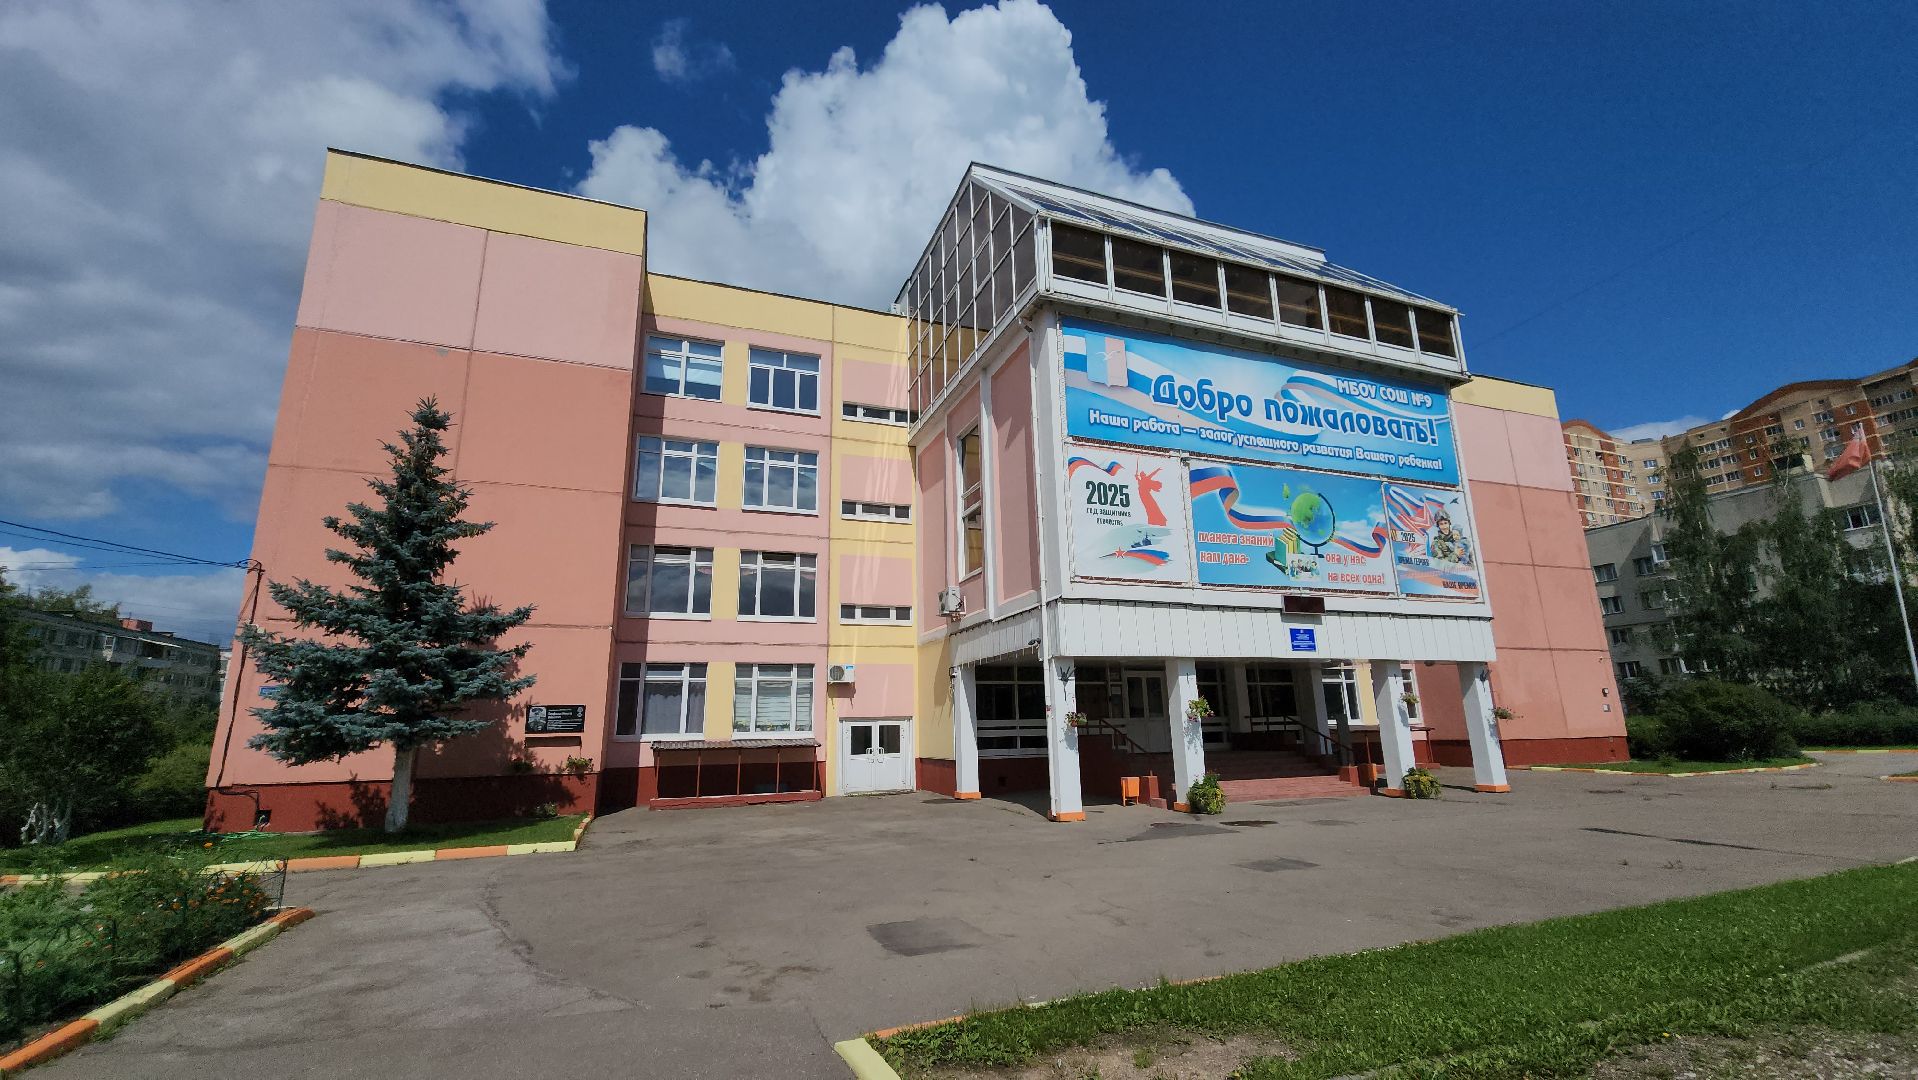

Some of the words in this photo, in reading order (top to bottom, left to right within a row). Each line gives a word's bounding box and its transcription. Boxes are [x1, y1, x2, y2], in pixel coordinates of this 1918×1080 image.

[1337, 379, 1376, 400] МБОУ
[1379, 386, 1409, 405] СОШ
[1411, 392, 1432, 409] №9
[1152, 374, 1253, 421] Добро
[1264, 398, 1438, 446] пожаловать!
[1089, 409, 1129, 428] Наша
[1133, 417, 1180, 434] работа
[1200, 428, 1233, 443] залог
[1236, 433, 1299, 451] успешного
[1302, 444, 1353, 459] развития
[1356, 448, 1396, 465] Вашего
[1398, 455, 1443, 470] ребенка!
[1085, 480, 1131, 508] 2025
[1198, 532, 1238, 544] планета
[1240, 533, 1274, 547] знаний
[1200, 551, 1220, 562] нам
[1325, 553, 1342, 563] она
[1327, 572, 1338, 582] на
[1340, 573, 1361, 583] всех
